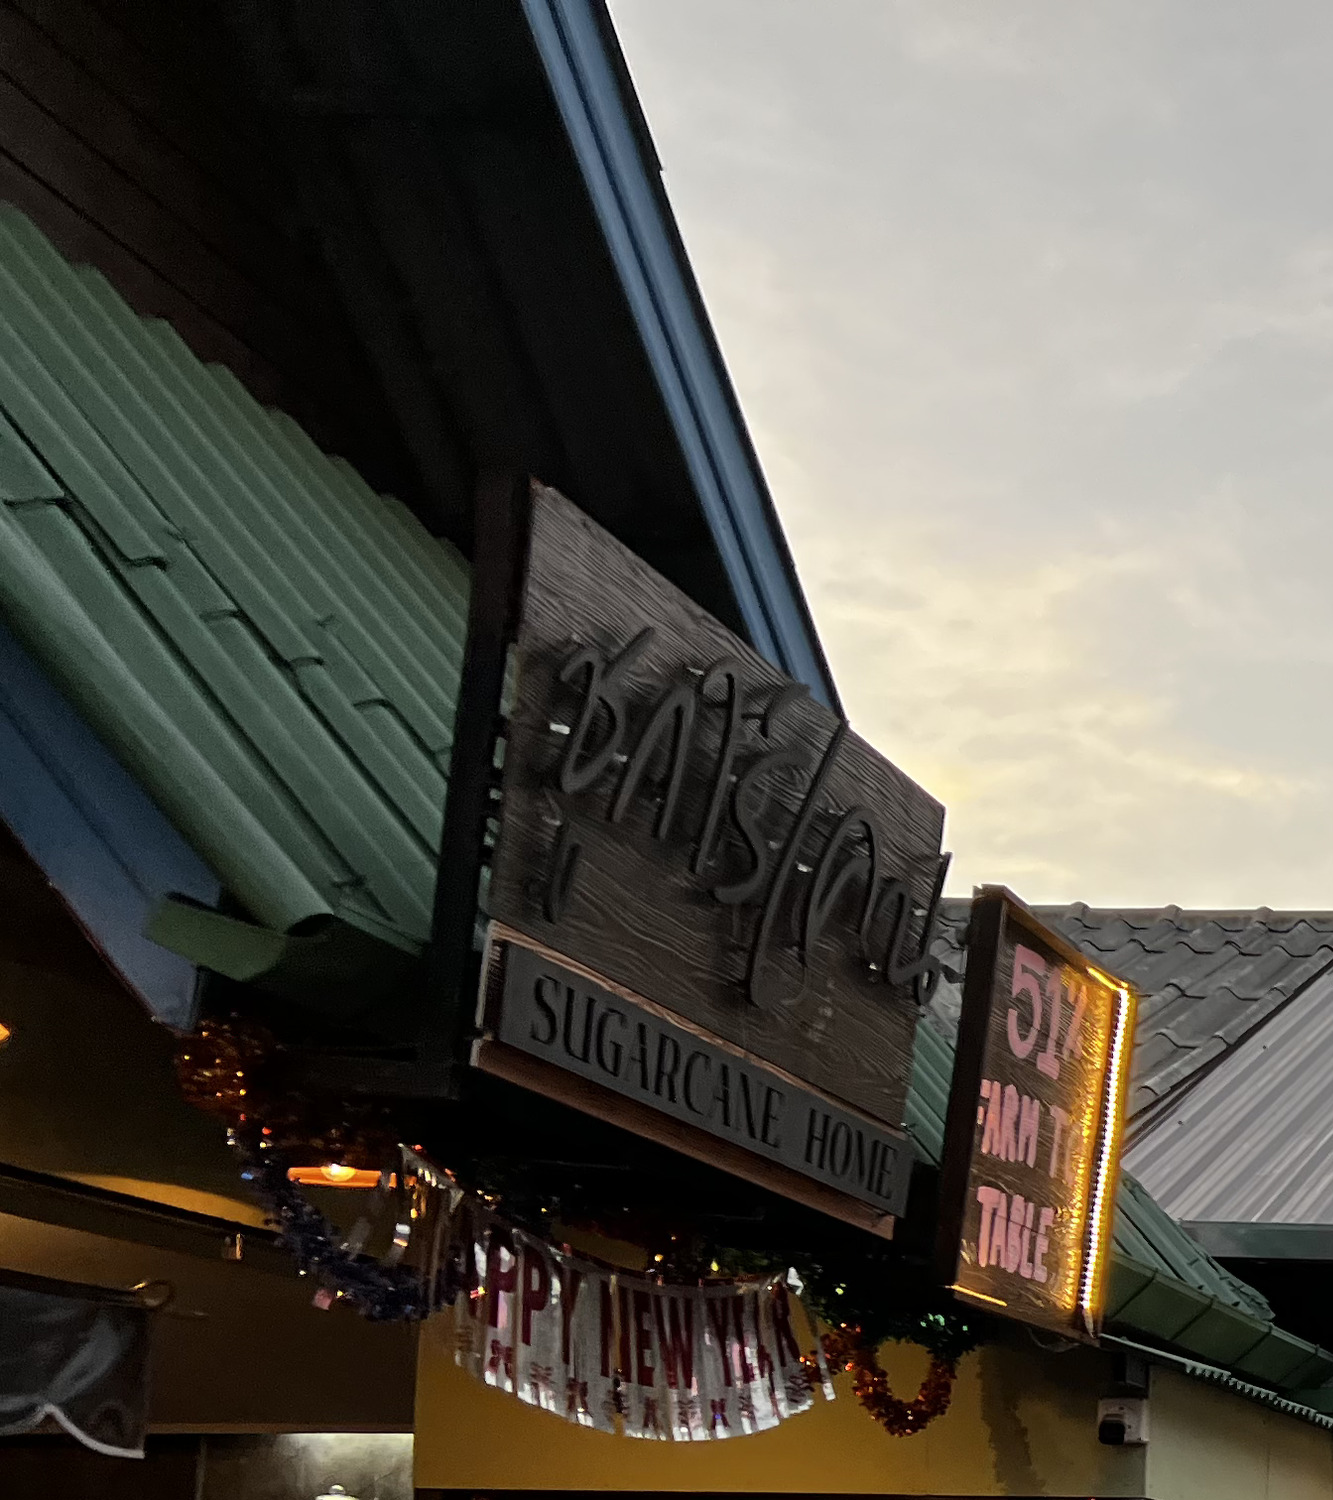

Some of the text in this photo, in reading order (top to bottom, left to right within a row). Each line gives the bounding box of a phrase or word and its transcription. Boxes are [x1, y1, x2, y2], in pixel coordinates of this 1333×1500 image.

[530, 973, 902, 1199] SUGARCANE HOME
[976, 1185, 1056, 1285] TABLE
[600, 1274, 698, 1391] NEW
